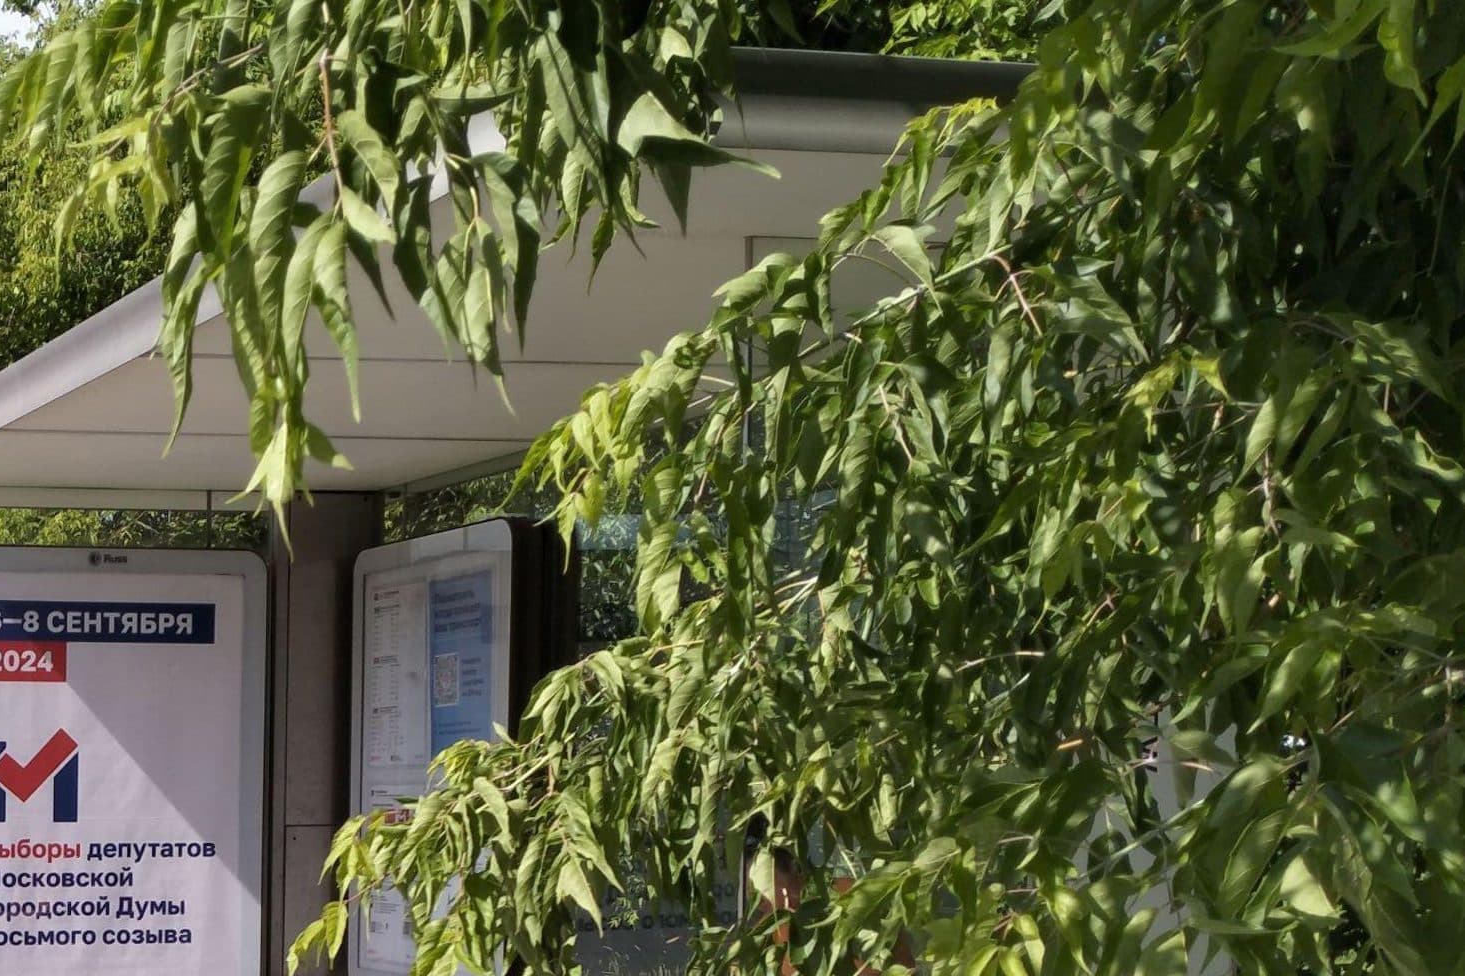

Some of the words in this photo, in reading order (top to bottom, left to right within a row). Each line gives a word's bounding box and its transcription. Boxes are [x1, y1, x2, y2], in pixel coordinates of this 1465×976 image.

[47, 611, 194, 635] СЕНТЯБРЯ
[87, 841, 217, 863] депутатов
[115, 896, 186, 920] Думы
[102, 928, 192, 945] созыва
